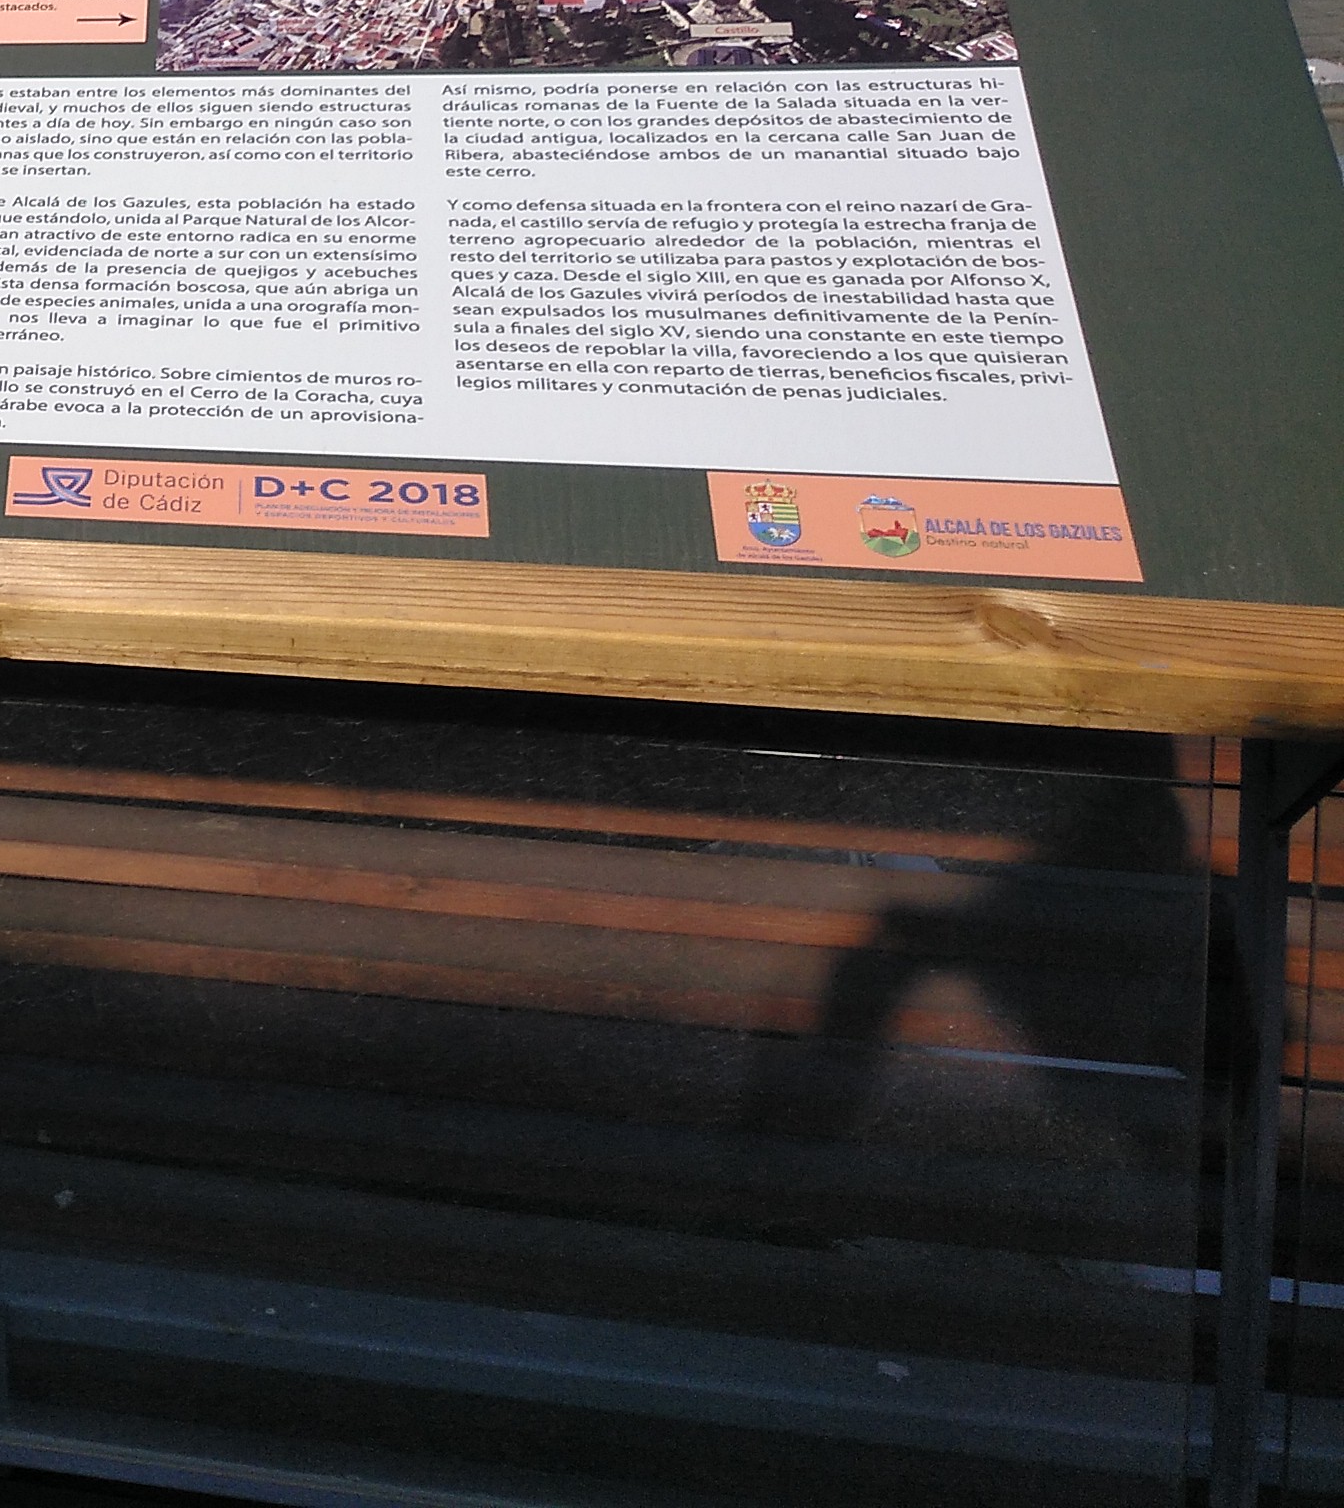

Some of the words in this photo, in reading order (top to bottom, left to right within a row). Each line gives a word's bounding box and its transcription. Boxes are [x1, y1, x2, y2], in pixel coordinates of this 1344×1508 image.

[9, 87, 70, 98] estaban
[76, 88, 118, 98] entre
[124, 86, 146, 97] los
[152, 86, 236, 97] elementos
[242, 86, 274, 97] más
[280, 85, 379, 96] dominantes
[384, 84, 410, 96] del
[442, 84, 467, 95] Así
[474, 84, 536, 96] mismo,
[543, 83, 599, 96] podría
[607, 85, 678, 96] ponerse
[685, 84, 708, 93] en
[716, 81, 787, 93] relación
[794, 83, 828, 92] con
[836, 79, 861, 91] las
[868, 79, 972, 91] estructuras
[979, 77, 1004, 90] hi-
[445, 166, 481, 177] este
[486, 168, 535, 177] cerro.
[9, 314, 38, 323] nos
[49, 312, 87, 324] lleva
[97, 316, 107, 325] a
[117, 314, 193, 329] imaginar
[204, 315, 220, 328] lo
[230, 319, 263, 331] que
[274, 316, 302, 329] fue
[312, 318, 328, 330] el
[339, 319, 420, 333] primitivo
[457, 375, 512, 391] legios
[517, 377, 598, 392] militares
[602, 383, 613, 395] y
[618, 382, 746, 396] conmutación
[752, 383, 777, 397] de
[782, 387, 842, 400] penas
[846, 386, 947, 402] judiciales.
[104, 469, 224, 490] Diputación
[254, 476, 350, 501] D+C
[368, 481, 480, 506] 2018
[102, 492, 129, 510] de
[140, 494, 201, 513] Cádiz
[925, 517, 987, 536] ALCALÁ
[990, 520, 1013, 537] DE
[1014, 522, 1046, 538] LOS
[1048, 524, 1123, 542] GAZULES
